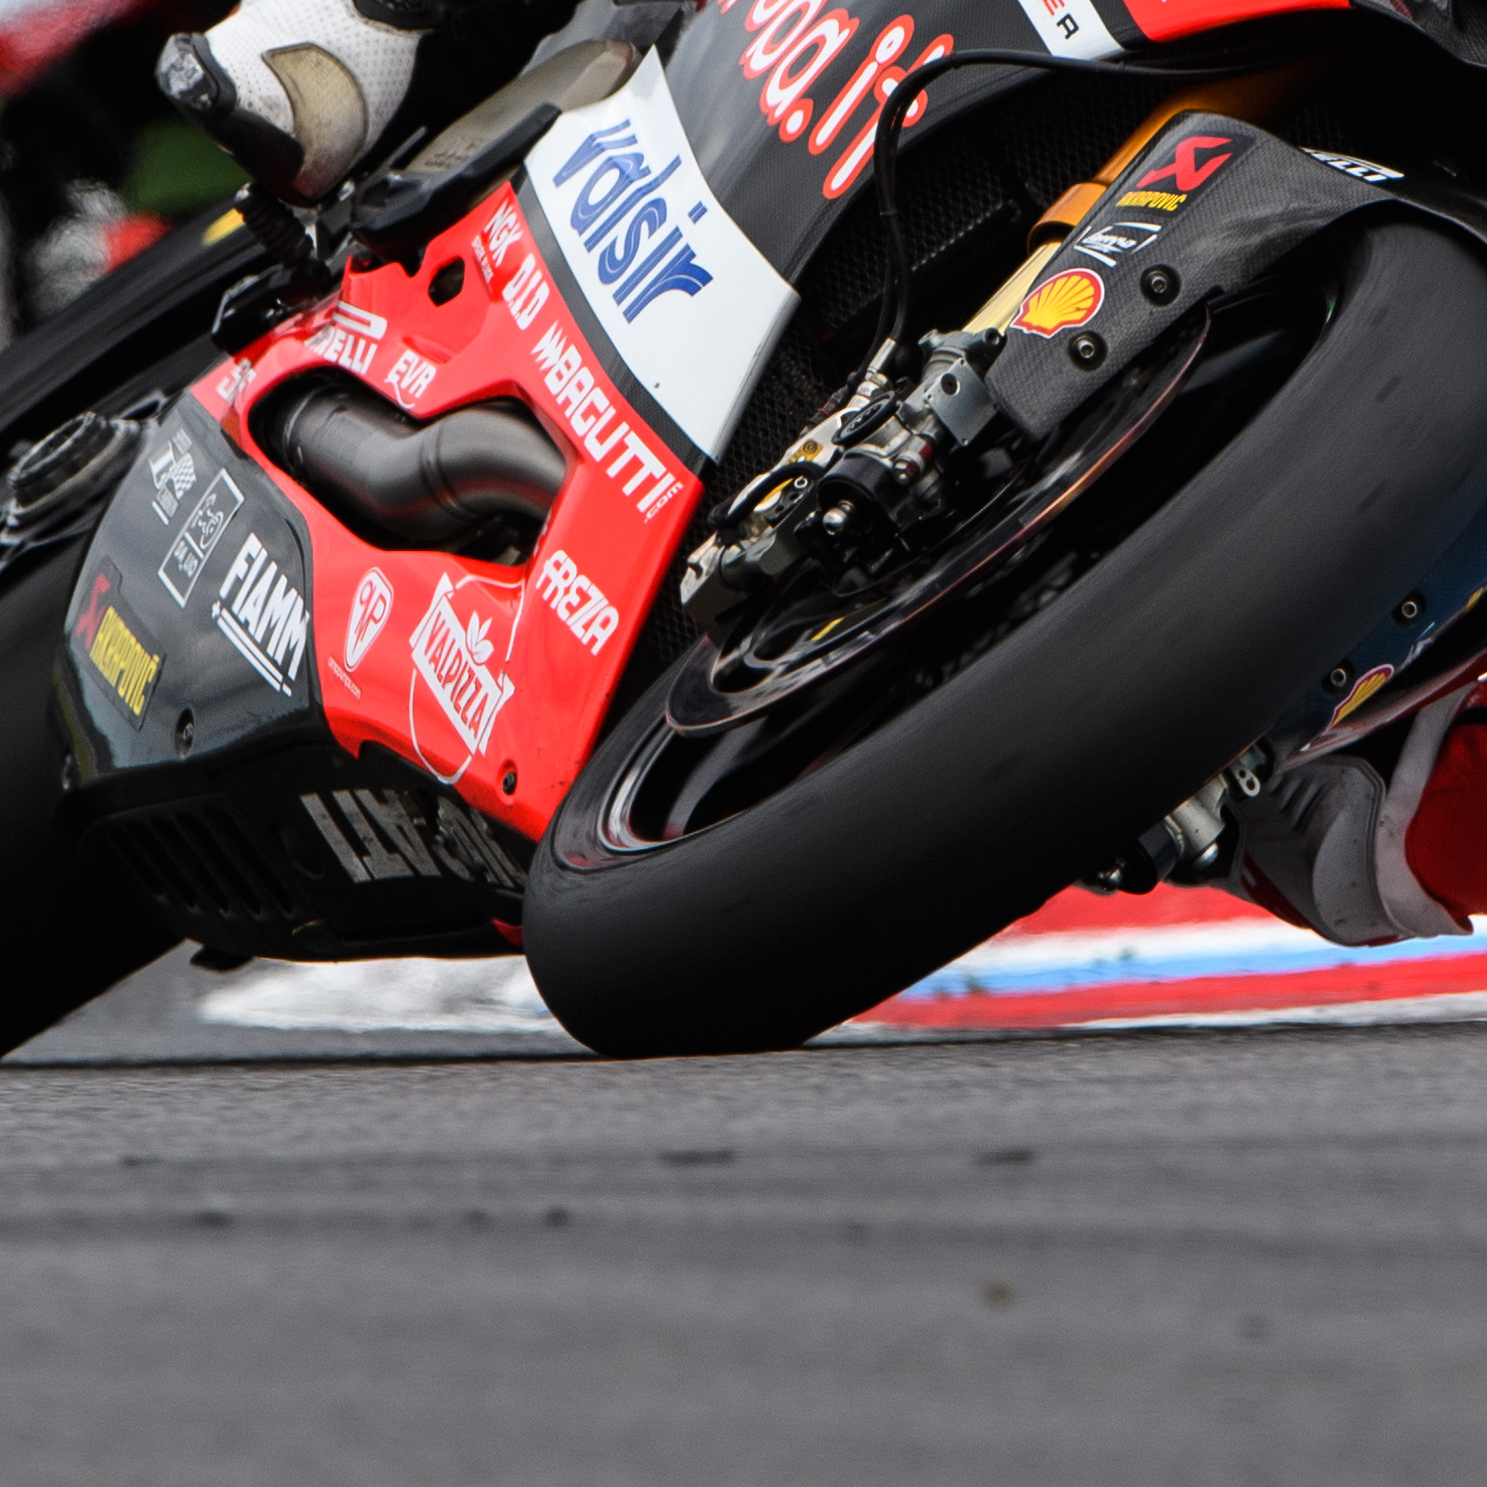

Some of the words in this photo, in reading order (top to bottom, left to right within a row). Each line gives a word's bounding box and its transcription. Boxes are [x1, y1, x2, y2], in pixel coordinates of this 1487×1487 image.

[1056, 13, 1080, 40] R
[483, 198, 524, 268] NGK
[553, 118, 713, 324] valsir
[643, 481, 684, 524] .com
[219, 532, 310, 683] FIAMM
[424, 608, 490, 741] VALPIZZA
